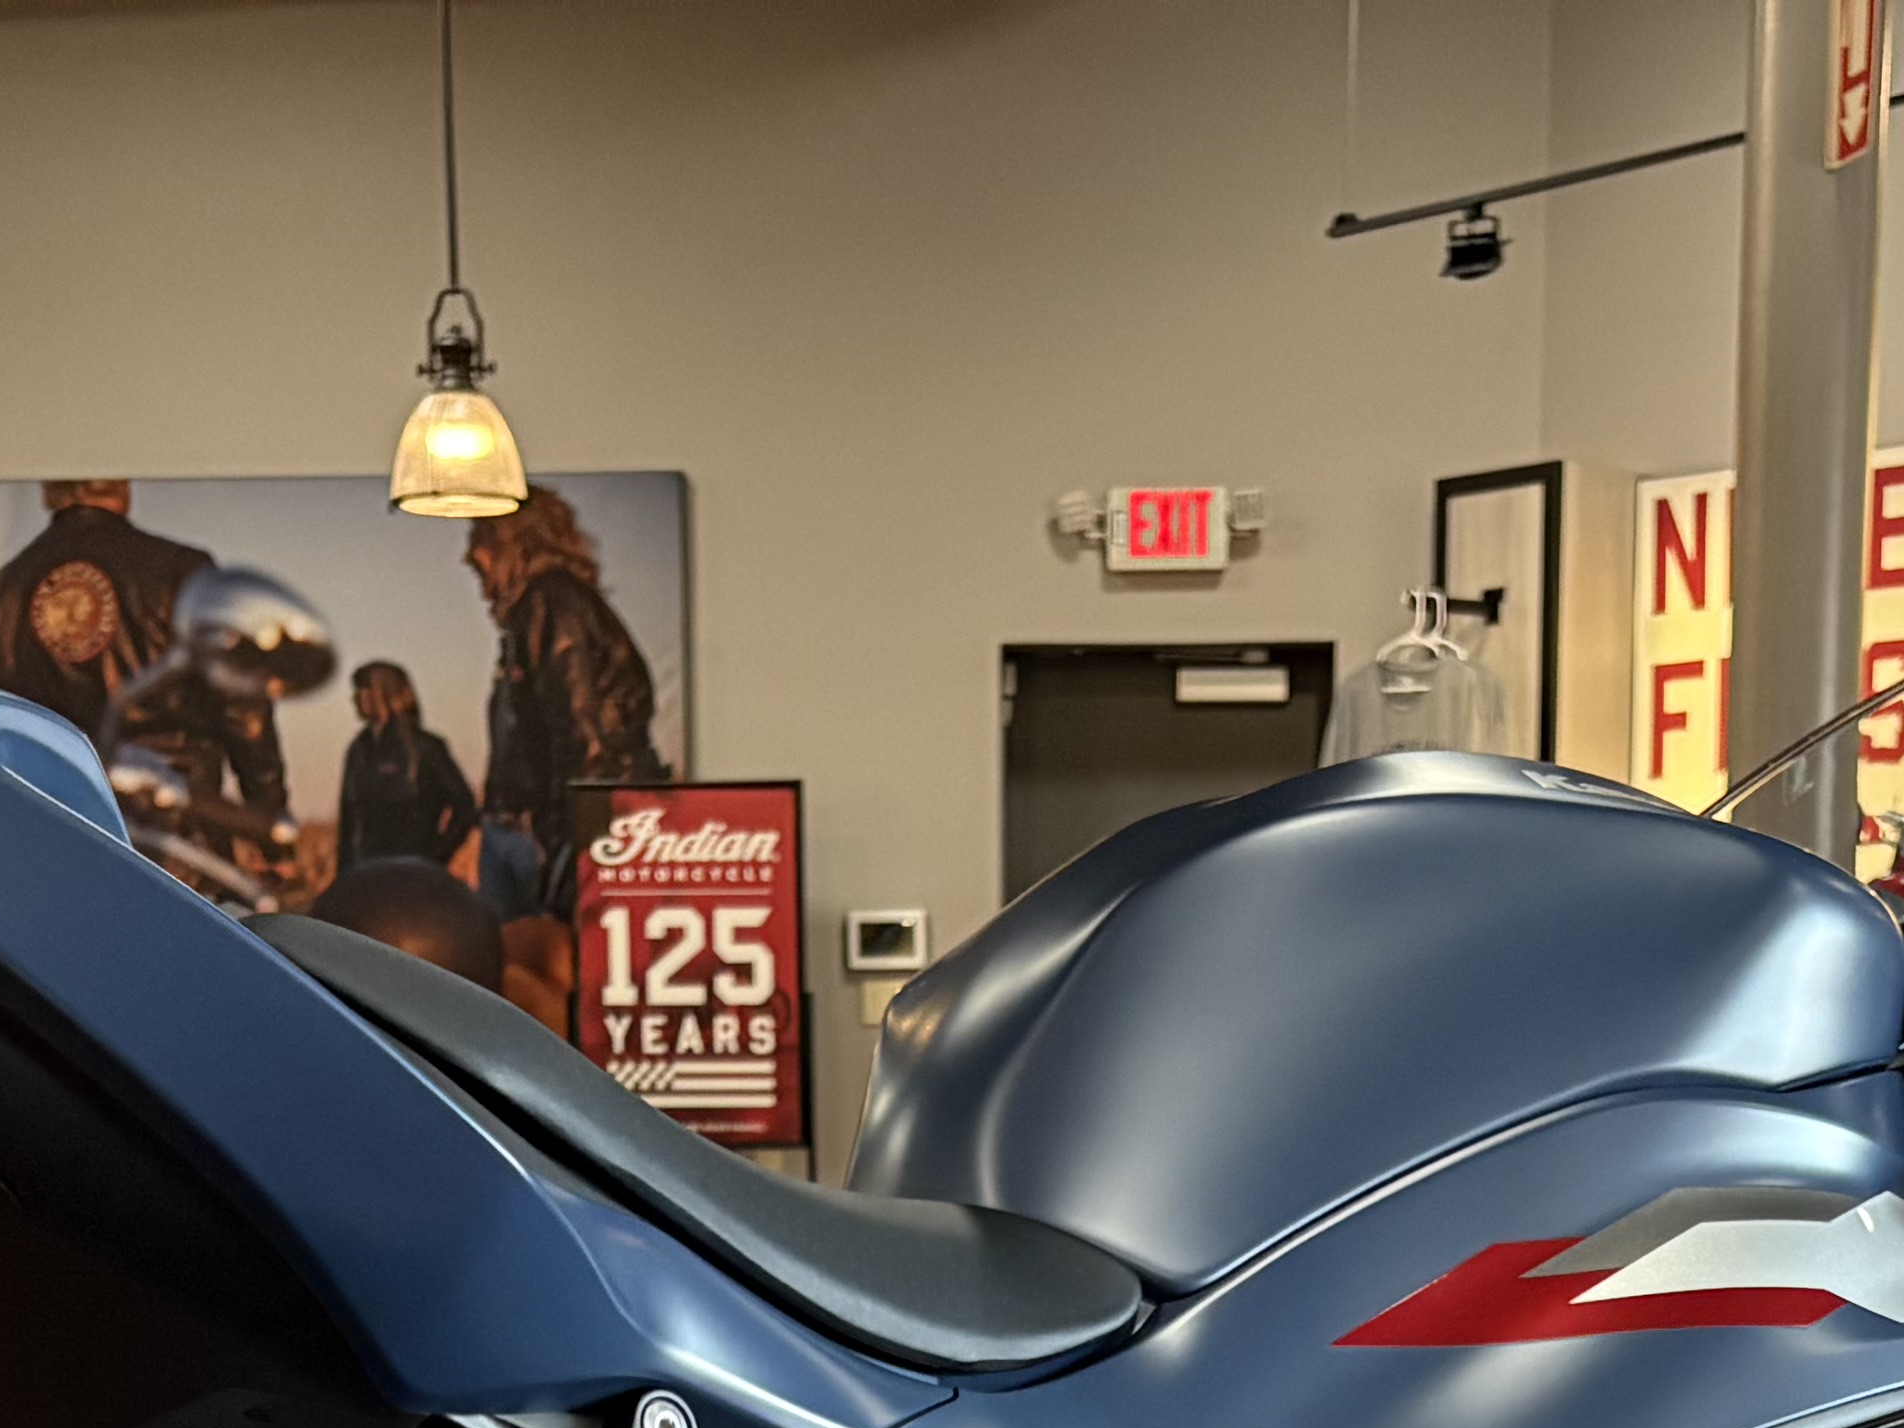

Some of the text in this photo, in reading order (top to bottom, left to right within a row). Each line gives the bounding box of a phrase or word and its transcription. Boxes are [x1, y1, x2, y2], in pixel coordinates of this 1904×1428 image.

[1128, 490, 1214, 558] EXIT
[589, 808, 781, 866] Indian
[600, 907, 776, 1007] 125
[603, 1013, 777, 1056] YEARS
